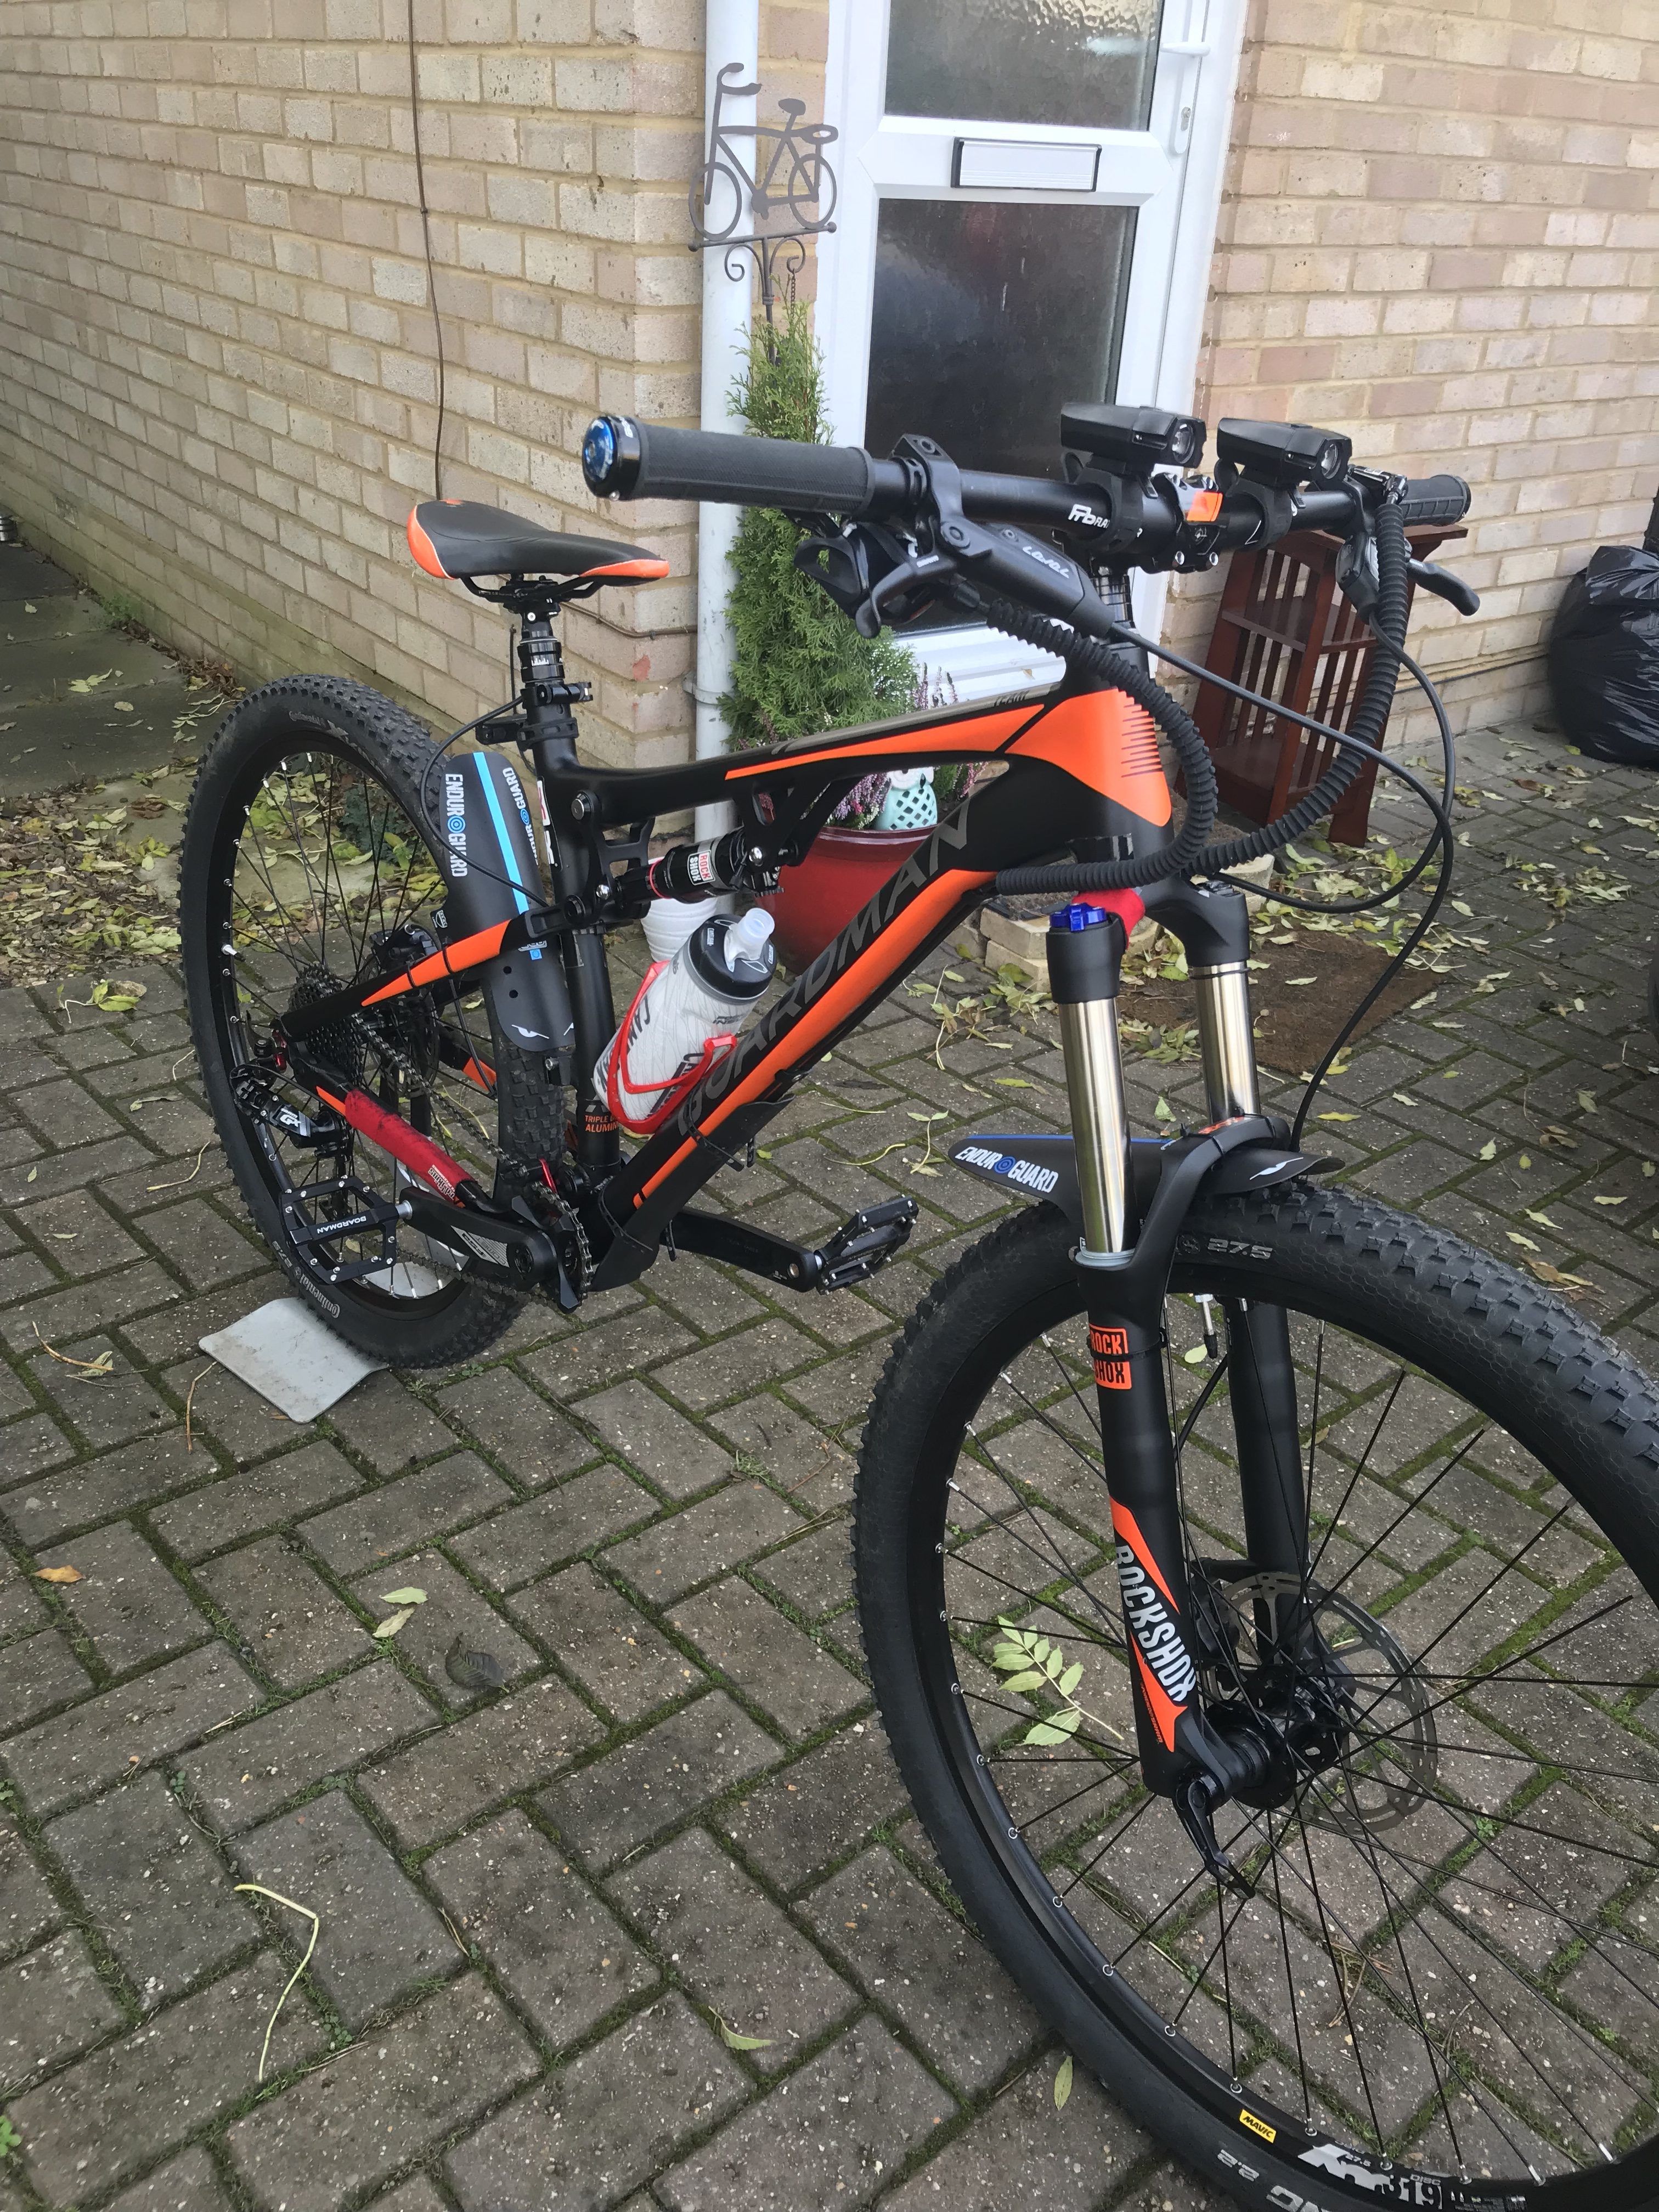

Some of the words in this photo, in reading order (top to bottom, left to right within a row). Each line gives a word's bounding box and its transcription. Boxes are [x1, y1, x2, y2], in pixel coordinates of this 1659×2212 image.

[690, 856, 702, 882] SHOX
[699, 853, 712, 880] ROCK
[678, 800, 969, 1136] BOARDMAN
[280, 1114, 302, 1127] GX
[317, 1216, 367, 1234] BOARDMAN
[1207, 1238, 1273, 1260] 27.5
[299, 1273, 341, 1318] Continental
[1090, 1329, 1123, 1355] ROCK
[1116, 1544, 1197, 1702] ROCKSHOX
[1243, 2116, 1274, 2138] MAVIC
[1410, 2174, 1442, 2186] DISC
